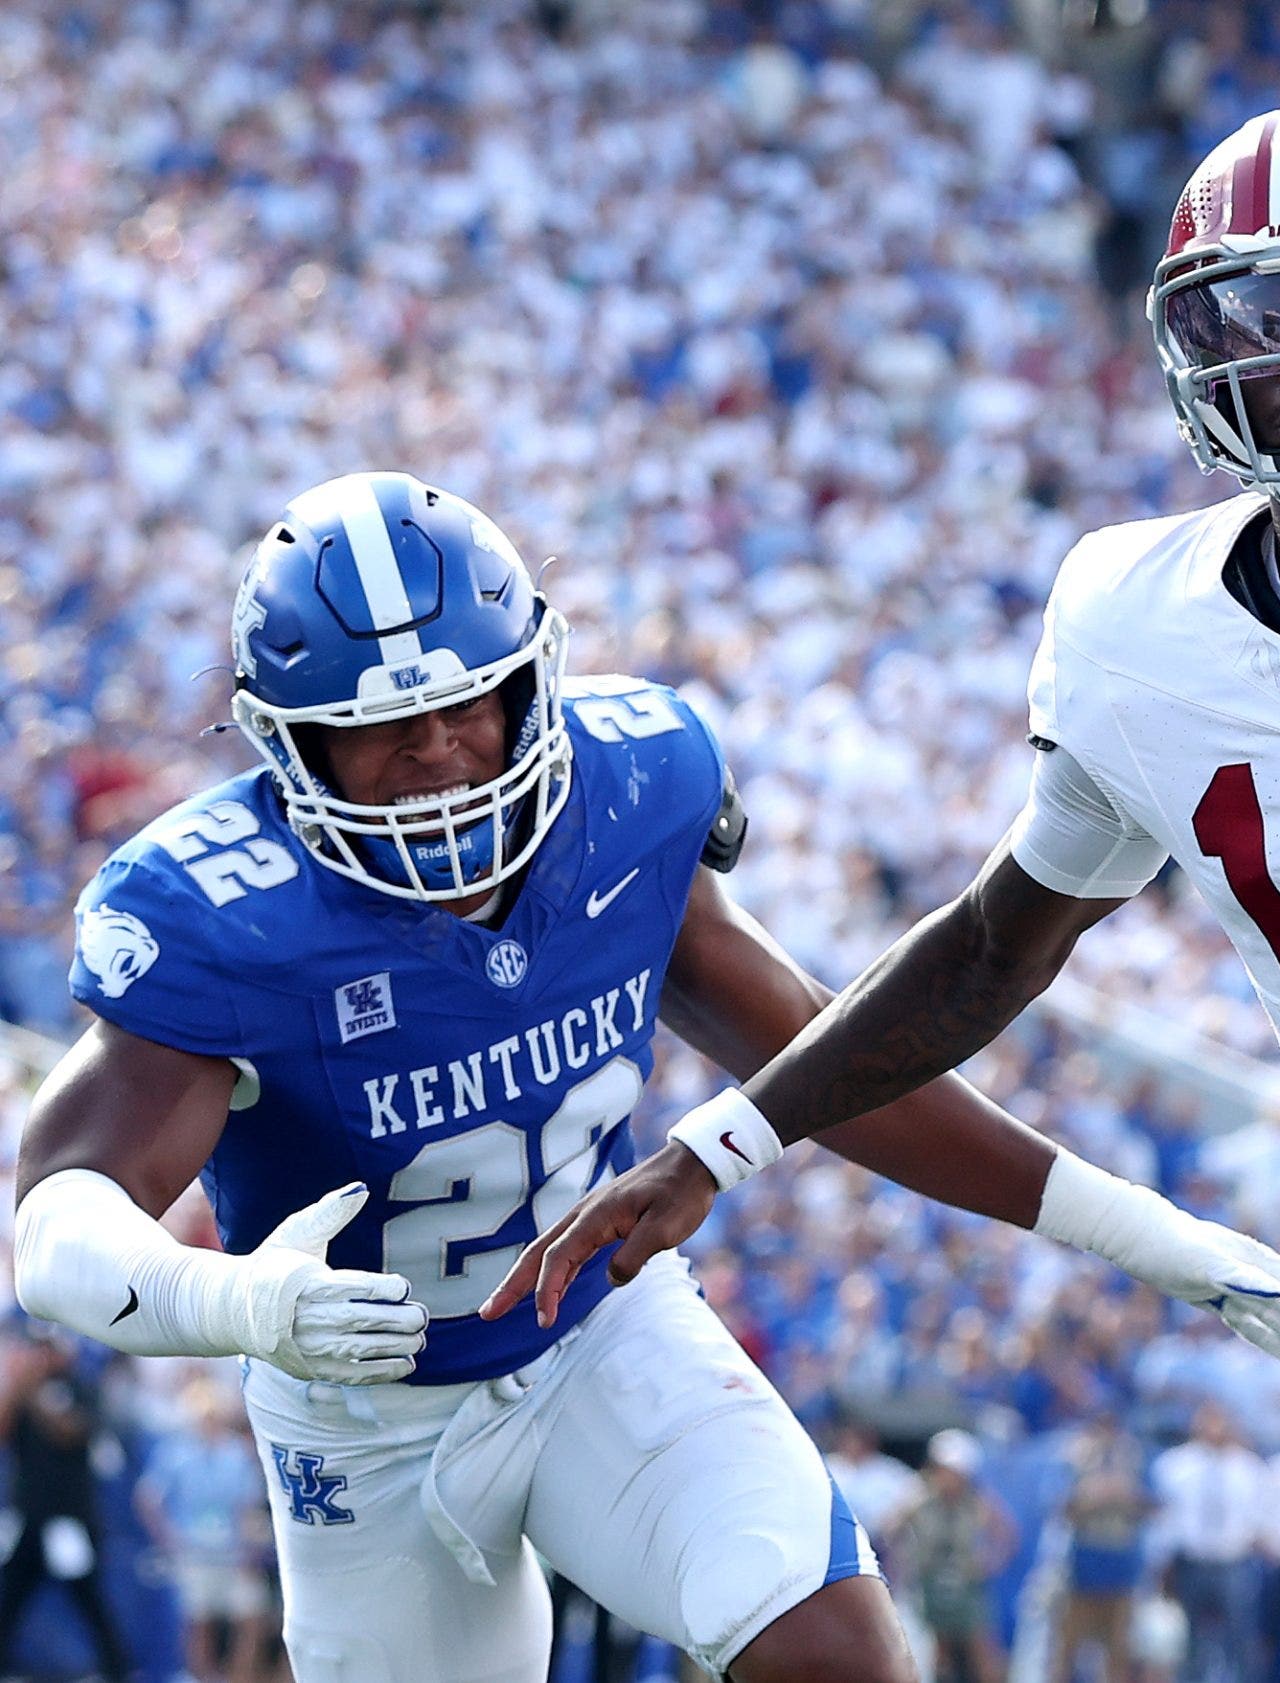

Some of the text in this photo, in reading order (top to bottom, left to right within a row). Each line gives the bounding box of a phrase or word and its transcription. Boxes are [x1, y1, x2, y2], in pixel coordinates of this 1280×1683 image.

[146, 799, 300, 910] 22
[489, 943, 525, 985] SEC
[345, 1010, 388, 1035] INVESTS
[363, 969, 651, 1139] KENTUCKY
[270, 1442, 356, 1526] UK
